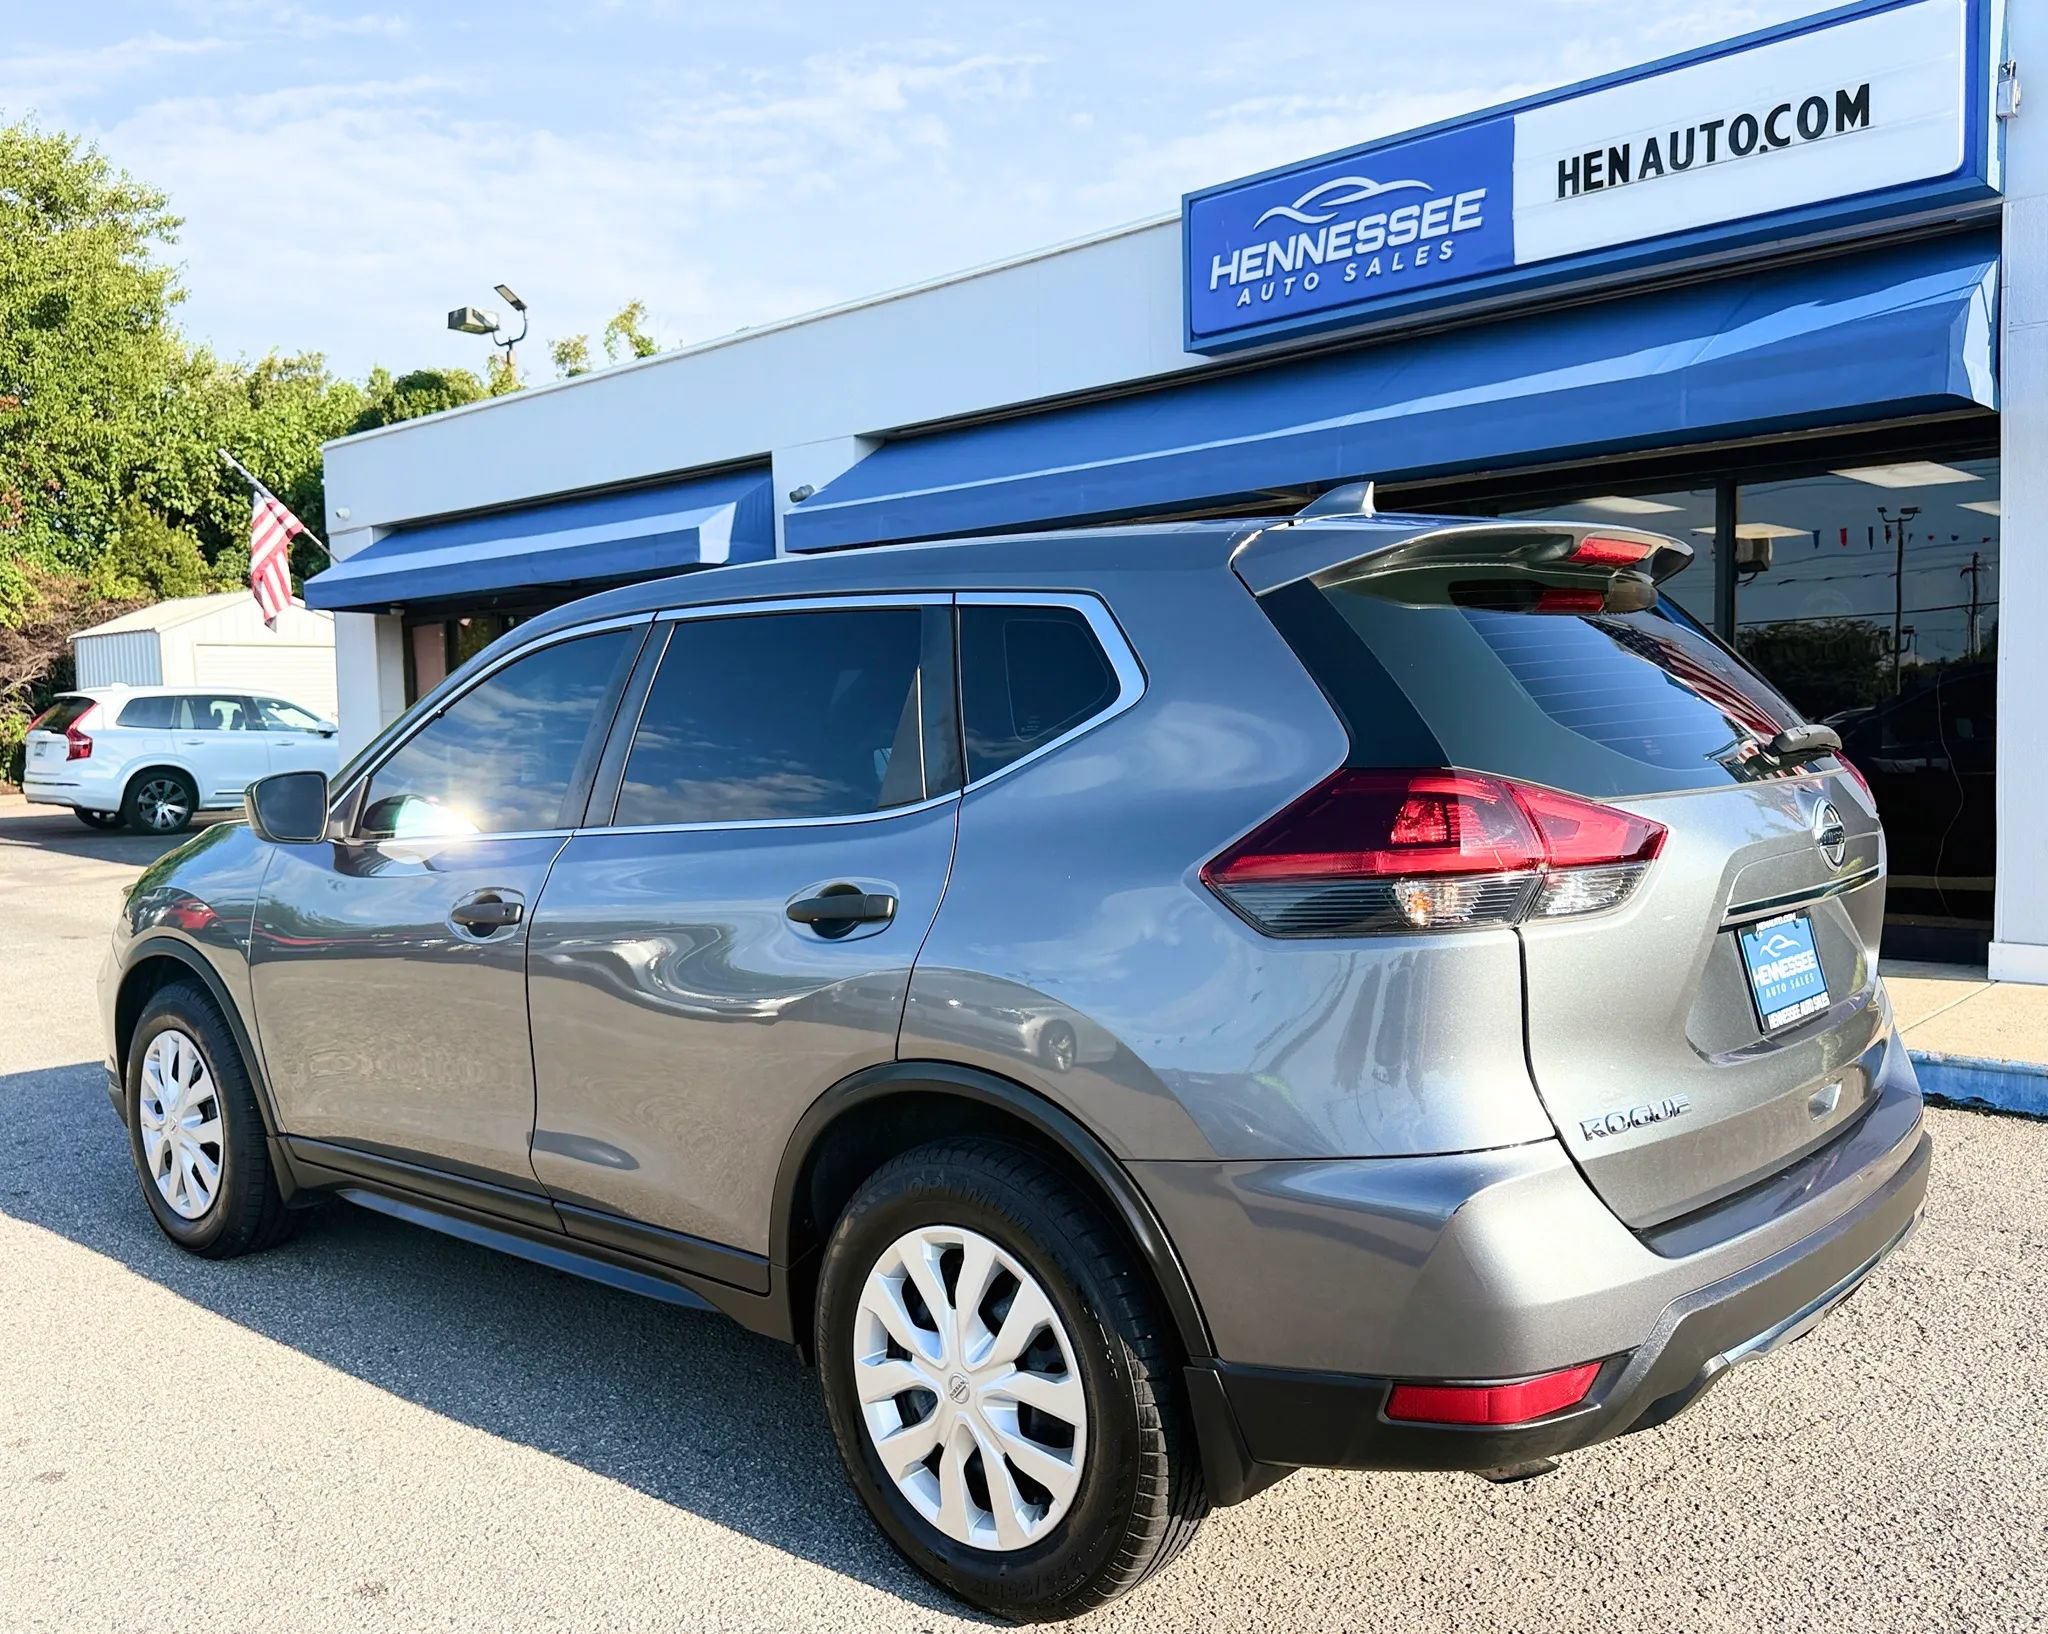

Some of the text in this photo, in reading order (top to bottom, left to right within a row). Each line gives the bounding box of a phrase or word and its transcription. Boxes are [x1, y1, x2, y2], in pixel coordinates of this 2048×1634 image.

[1557, 83, 1870, 198] HENAUTO.COM
[1209, 188, 1487, 290] HENNESSEE
[1236, 240, 1454, 307] AUTO SALES
[1752, 949, 1817, 988] HENNESSEE
[1765, 972, 1815, 999] AUTO SALES
[1579, 1093, 1692, 1141] ROGUE
